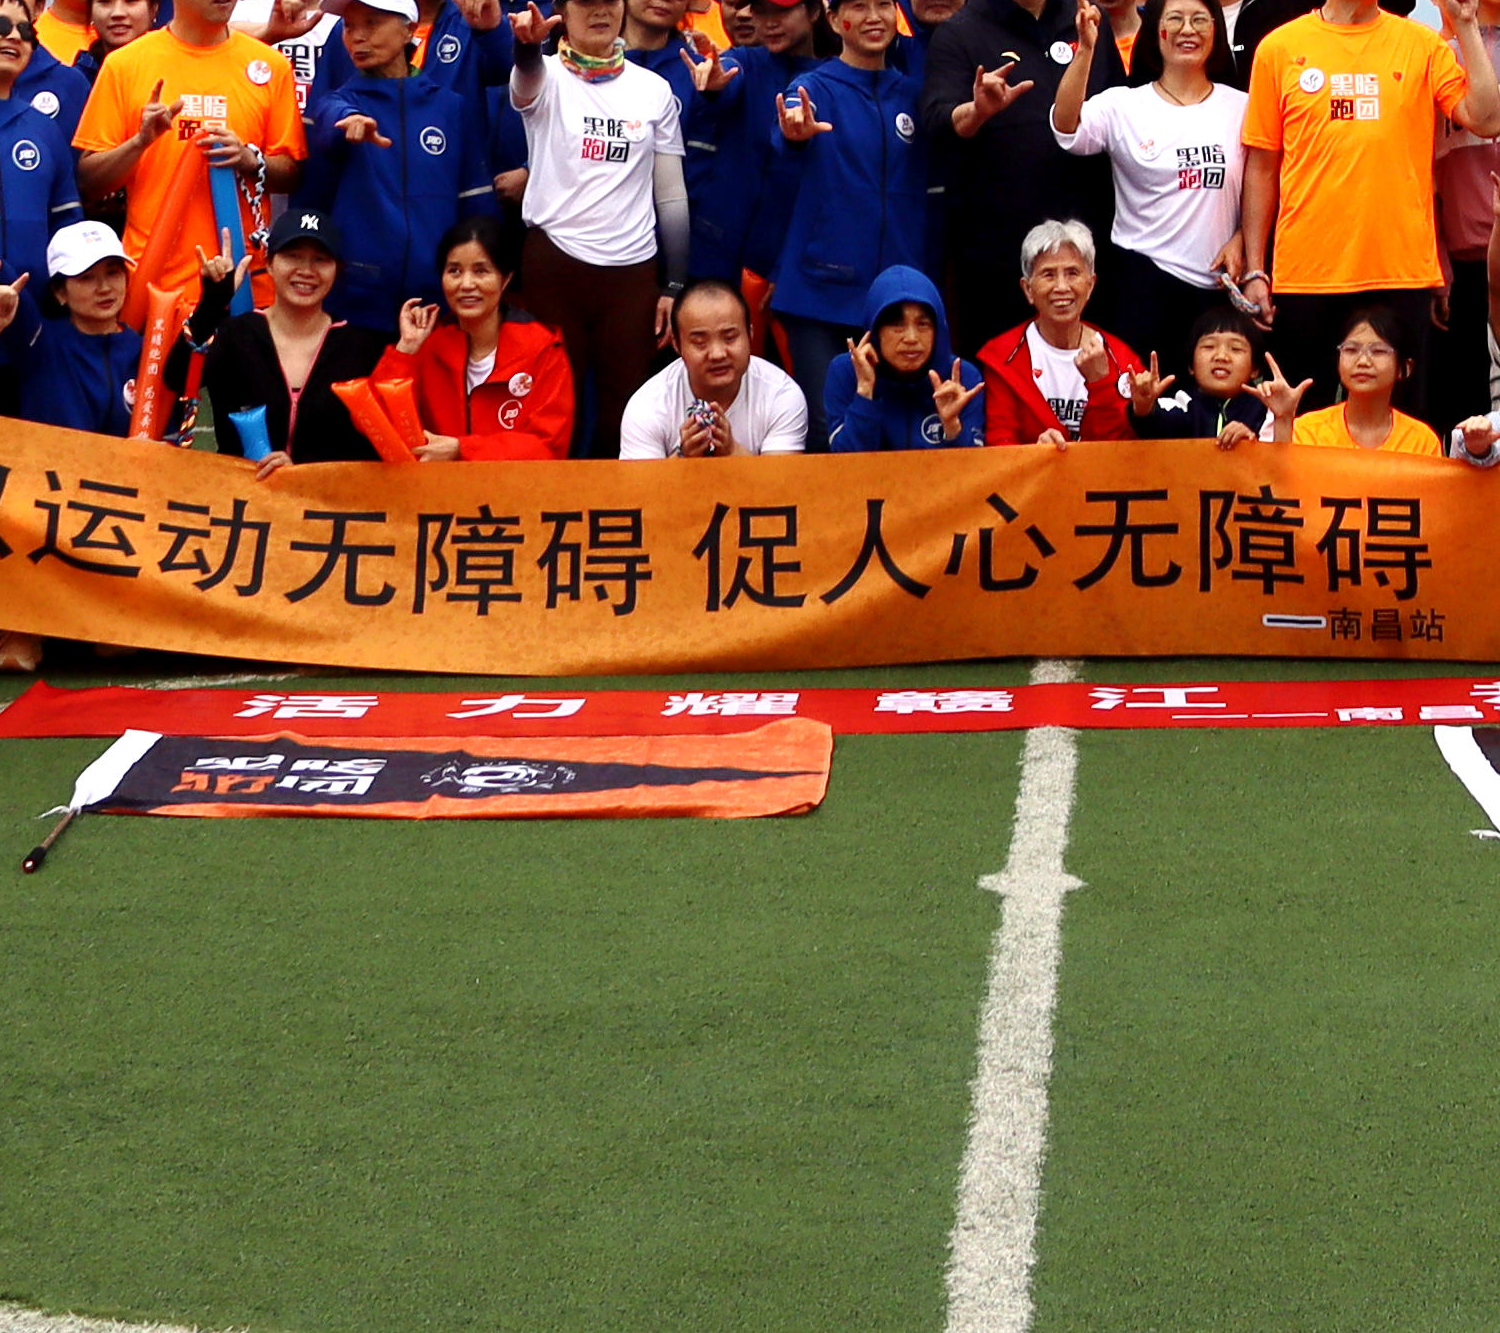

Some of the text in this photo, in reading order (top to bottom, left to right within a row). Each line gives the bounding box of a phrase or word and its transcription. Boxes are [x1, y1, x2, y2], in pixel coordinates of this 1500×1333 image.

[1330, 73, 1380, 97] 黑暗
[180, 94, 227, 118] 黑暗
[1330, 98, 1380, 121] 跑团
[583, 116, 628, 137] 黑暗
[581, 140, 630, 164] 跑团
[1176, 144, 1227, 167] 黑暗
[1177, 167, 1226, 190] 跑团
[699, 485, 1433, 613] 促人心无障碍
[232, 685, 1228, 721] 活力耀赣江
